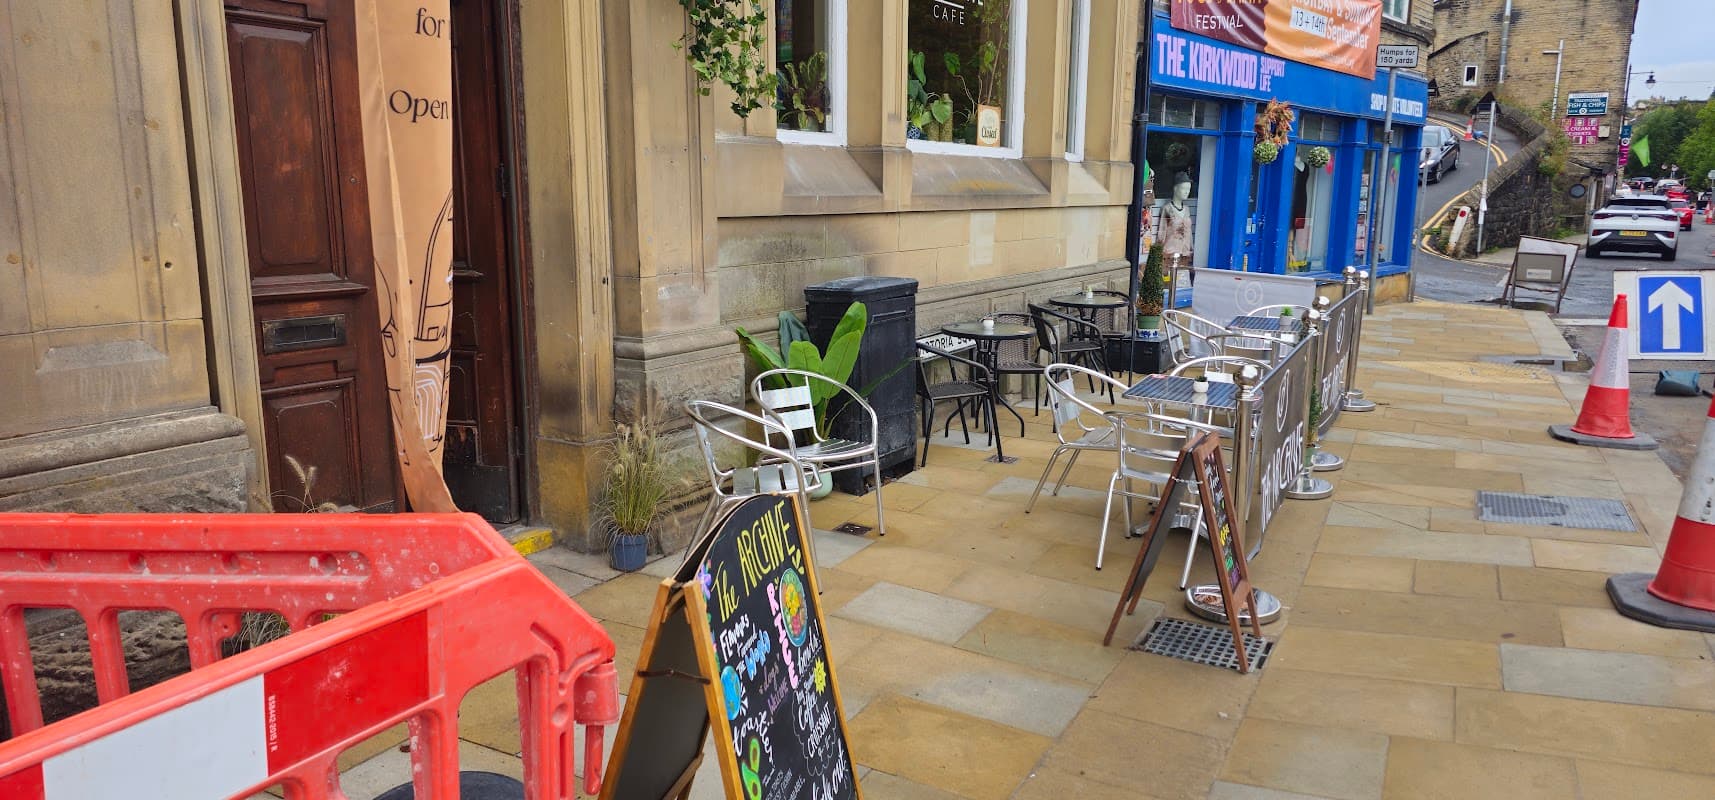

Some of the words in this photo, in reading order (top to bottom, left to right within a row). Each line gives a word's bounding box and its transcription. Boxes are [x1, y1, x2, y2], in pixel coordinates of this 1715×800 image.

[415, 7, 446, 38] for
[933, 4, 965, 25] CAFE
[1196, 14, 1244, 30] FESTIVAL
[1295, 10, 1304, 27] 13
[1311, 15, 1326, 34] 14th
[1326, 17, 1369, 49] September
[1157, 33, 1187, 78] THE
[1189, 41, 1258, 89] KIRKWOOD
[1380, 48, 1404, 57] Humps
[1405, 48, 1416, 56] for
[1380, 56, 1393, 64] 150
[1395, 56, 1414, 65] yards
[1260, 56, 1286, 77] SUPPORT
[1259, 74, 1271, 92] LIFE
[389, 89, 449, 123] Open
[1272, 421, 1304, 510] ARCHIVE
[711, 561, 740, 623] The
[737, 500, 796, 597] ARCHIVE
[767, 582, 799, 690] RICE
